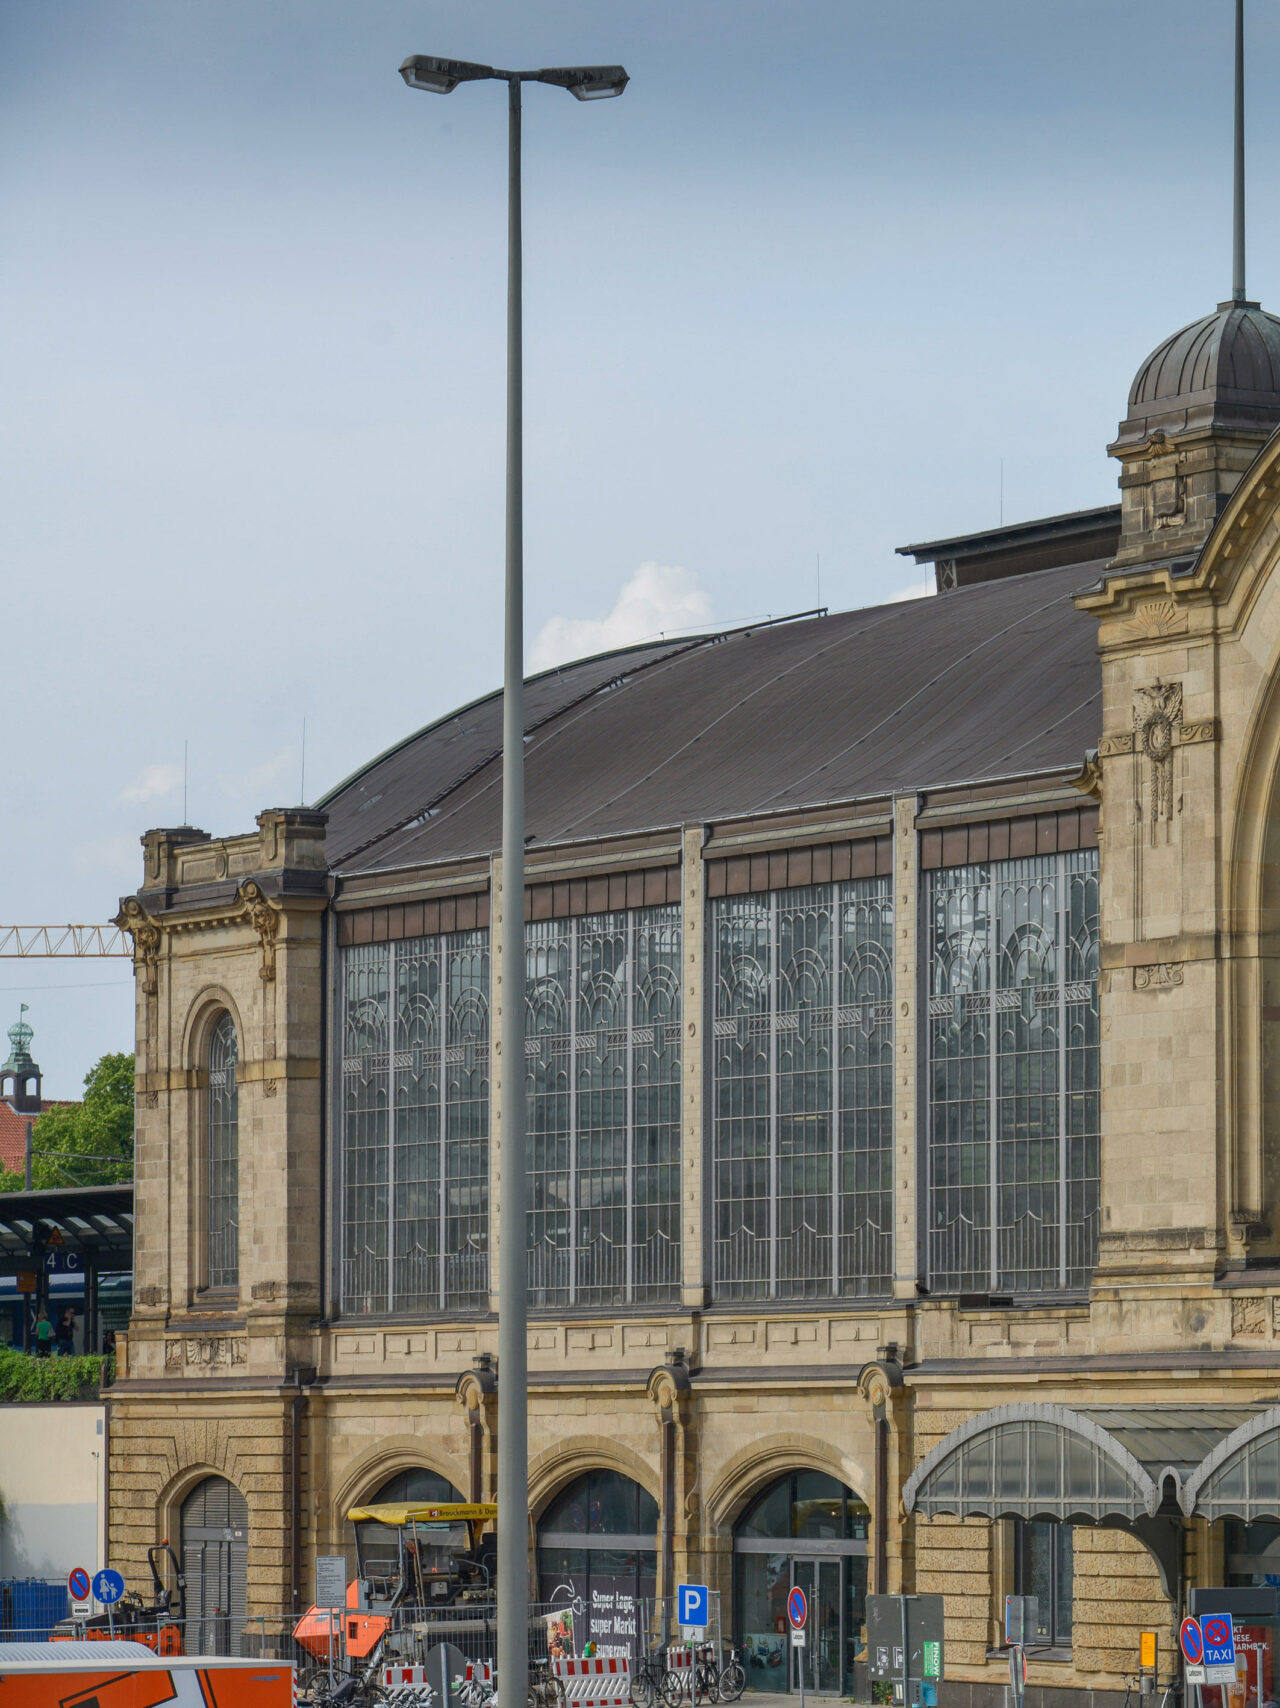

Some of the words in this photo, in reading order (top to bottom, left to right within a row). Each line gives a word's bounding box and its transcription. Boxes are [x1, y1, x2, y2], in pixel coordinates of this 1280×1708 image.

[46, 1252, 56, 1268] 4
[66, 1252, 77, 1269] C
[592, 1589, 614, 1613] Super
[616, 1591, 635, 1614] Lage,
[684, 1589, 701, 1621] P
[590, 1618, 612, 1637] super
[614, 1615, 637, 1638] Markt,
[1206, 1649, 1232, 1661] TAXI
